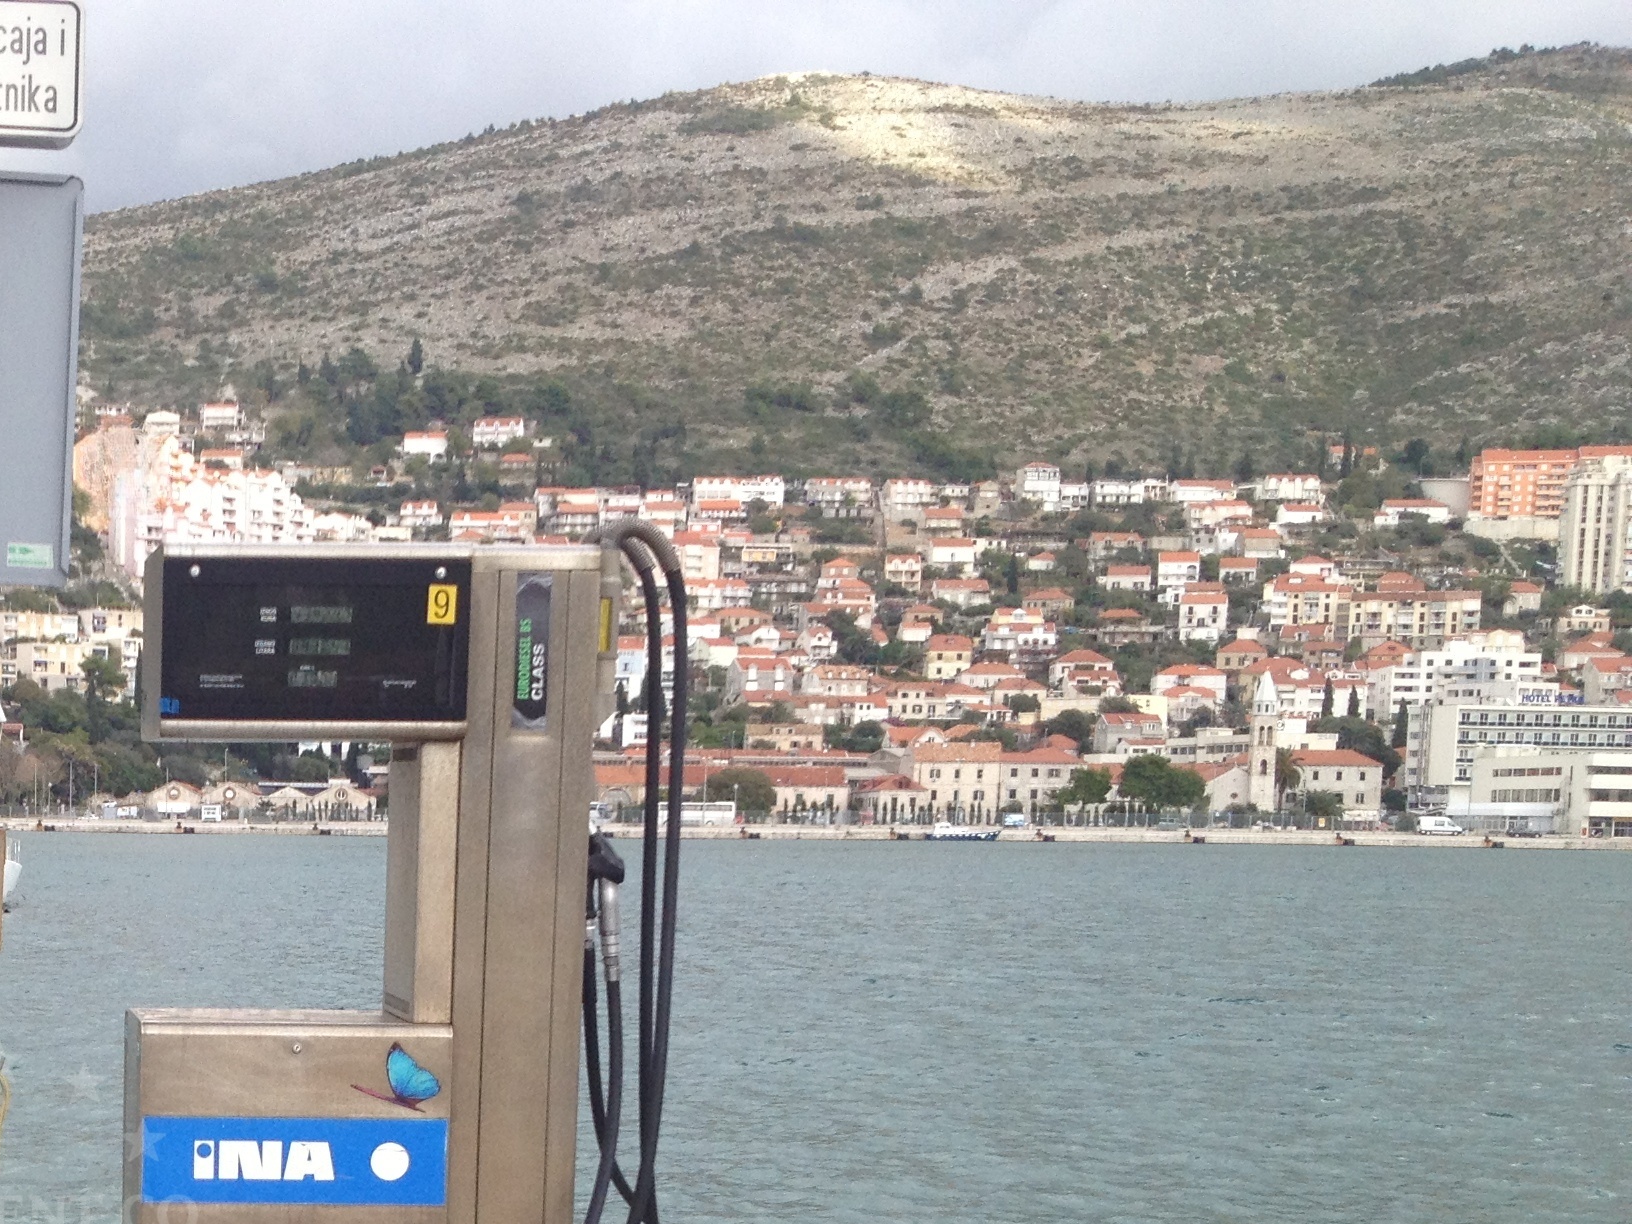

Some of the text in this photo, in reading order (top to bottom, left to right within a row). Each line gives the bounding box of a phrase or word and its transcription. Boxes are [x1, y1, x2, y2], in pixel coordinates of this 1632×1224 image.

[60, 18, 66, 56] i
[434, 589, 449, 619] 9
[531, 643, 545, 700] CLASS
[1521, 694, 1551, 703] HOTEL
